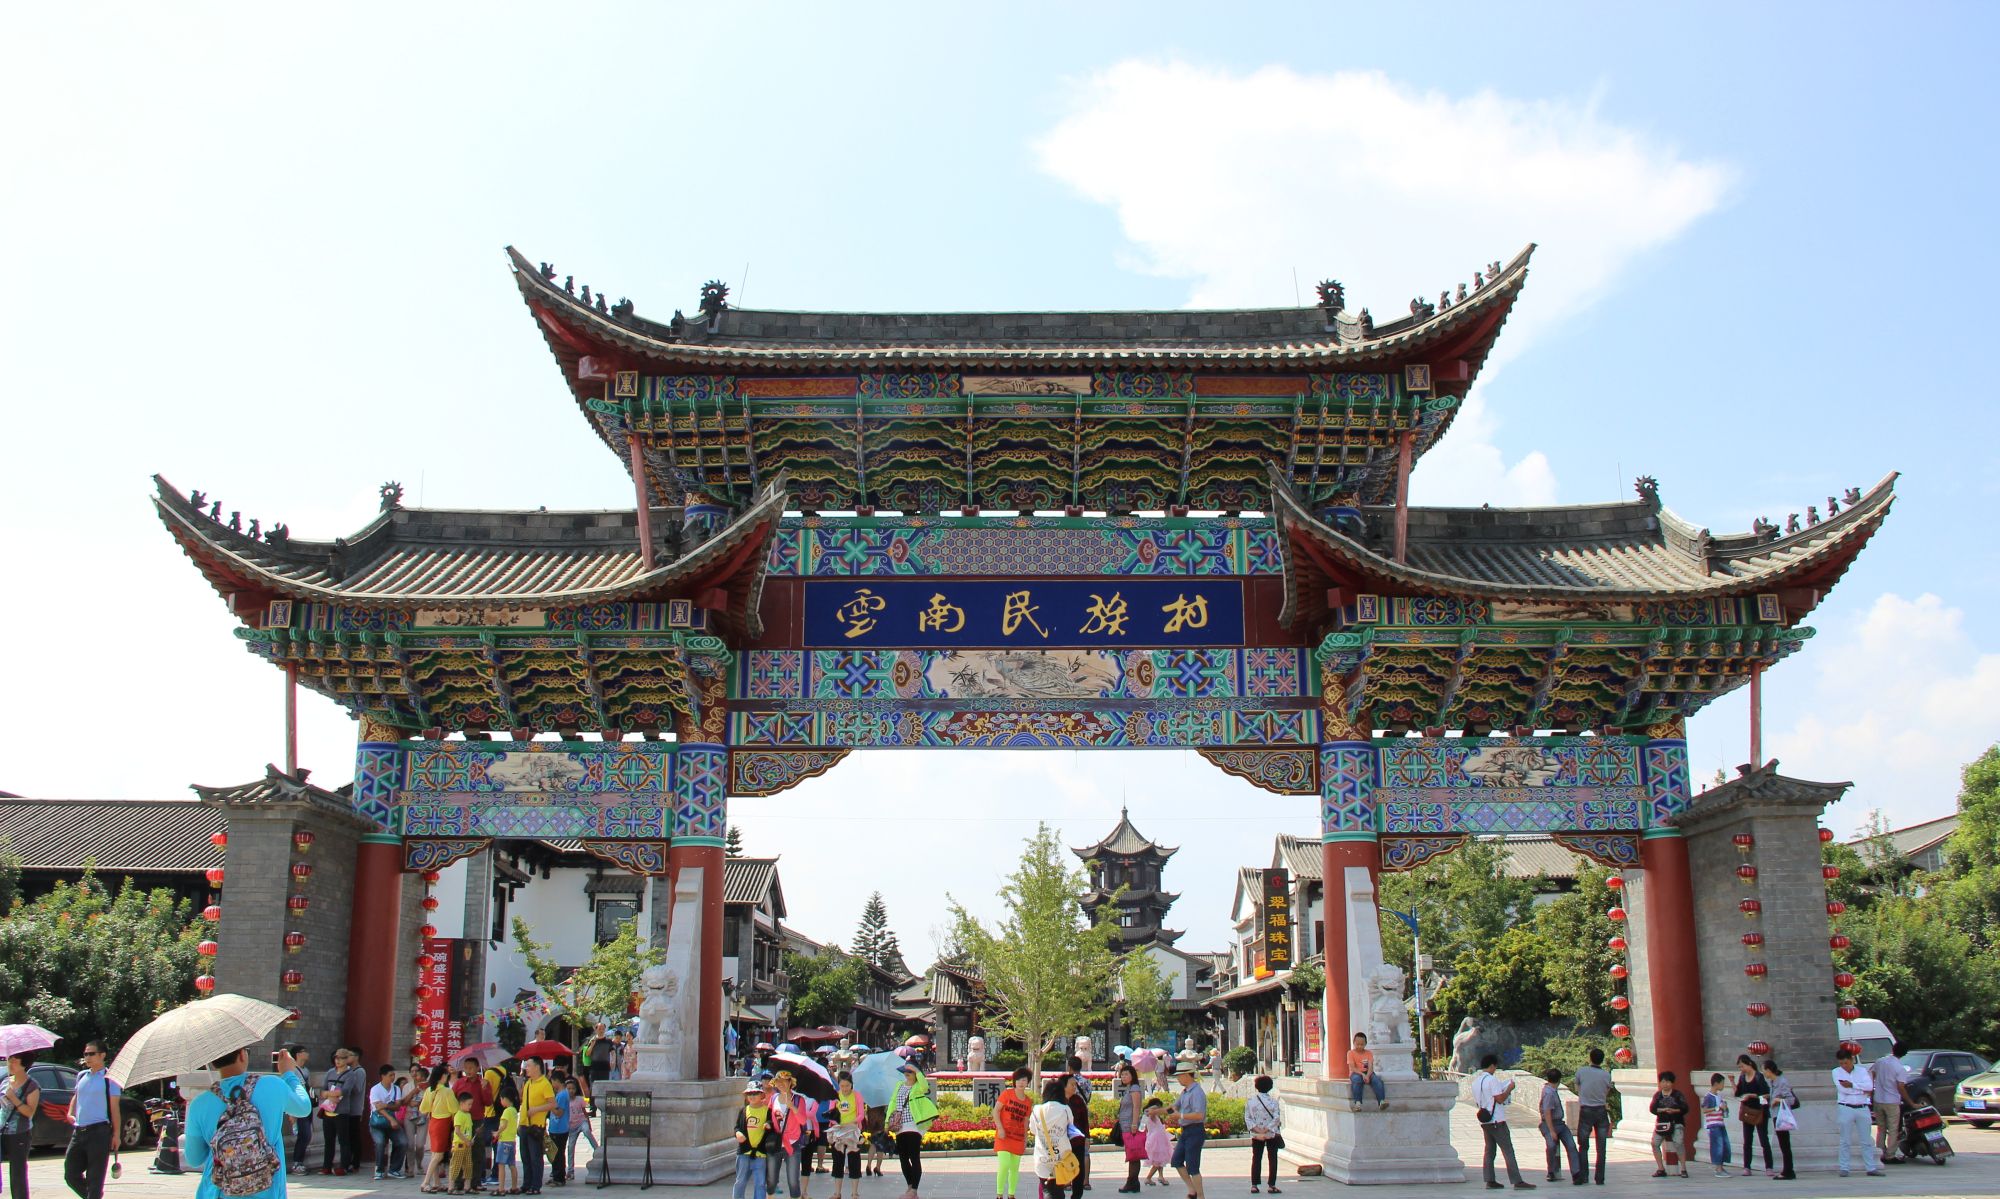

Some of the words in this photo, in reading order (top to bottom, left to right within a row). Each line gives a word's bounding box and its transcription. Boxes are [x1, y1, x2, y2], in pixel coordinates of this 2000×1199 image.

[1268, 895, 1289, 962] 翠福珠宝
[432, 943, 447, 997] 一碗盛天下
[430, 1009, 445, 1066] 调和千万家
